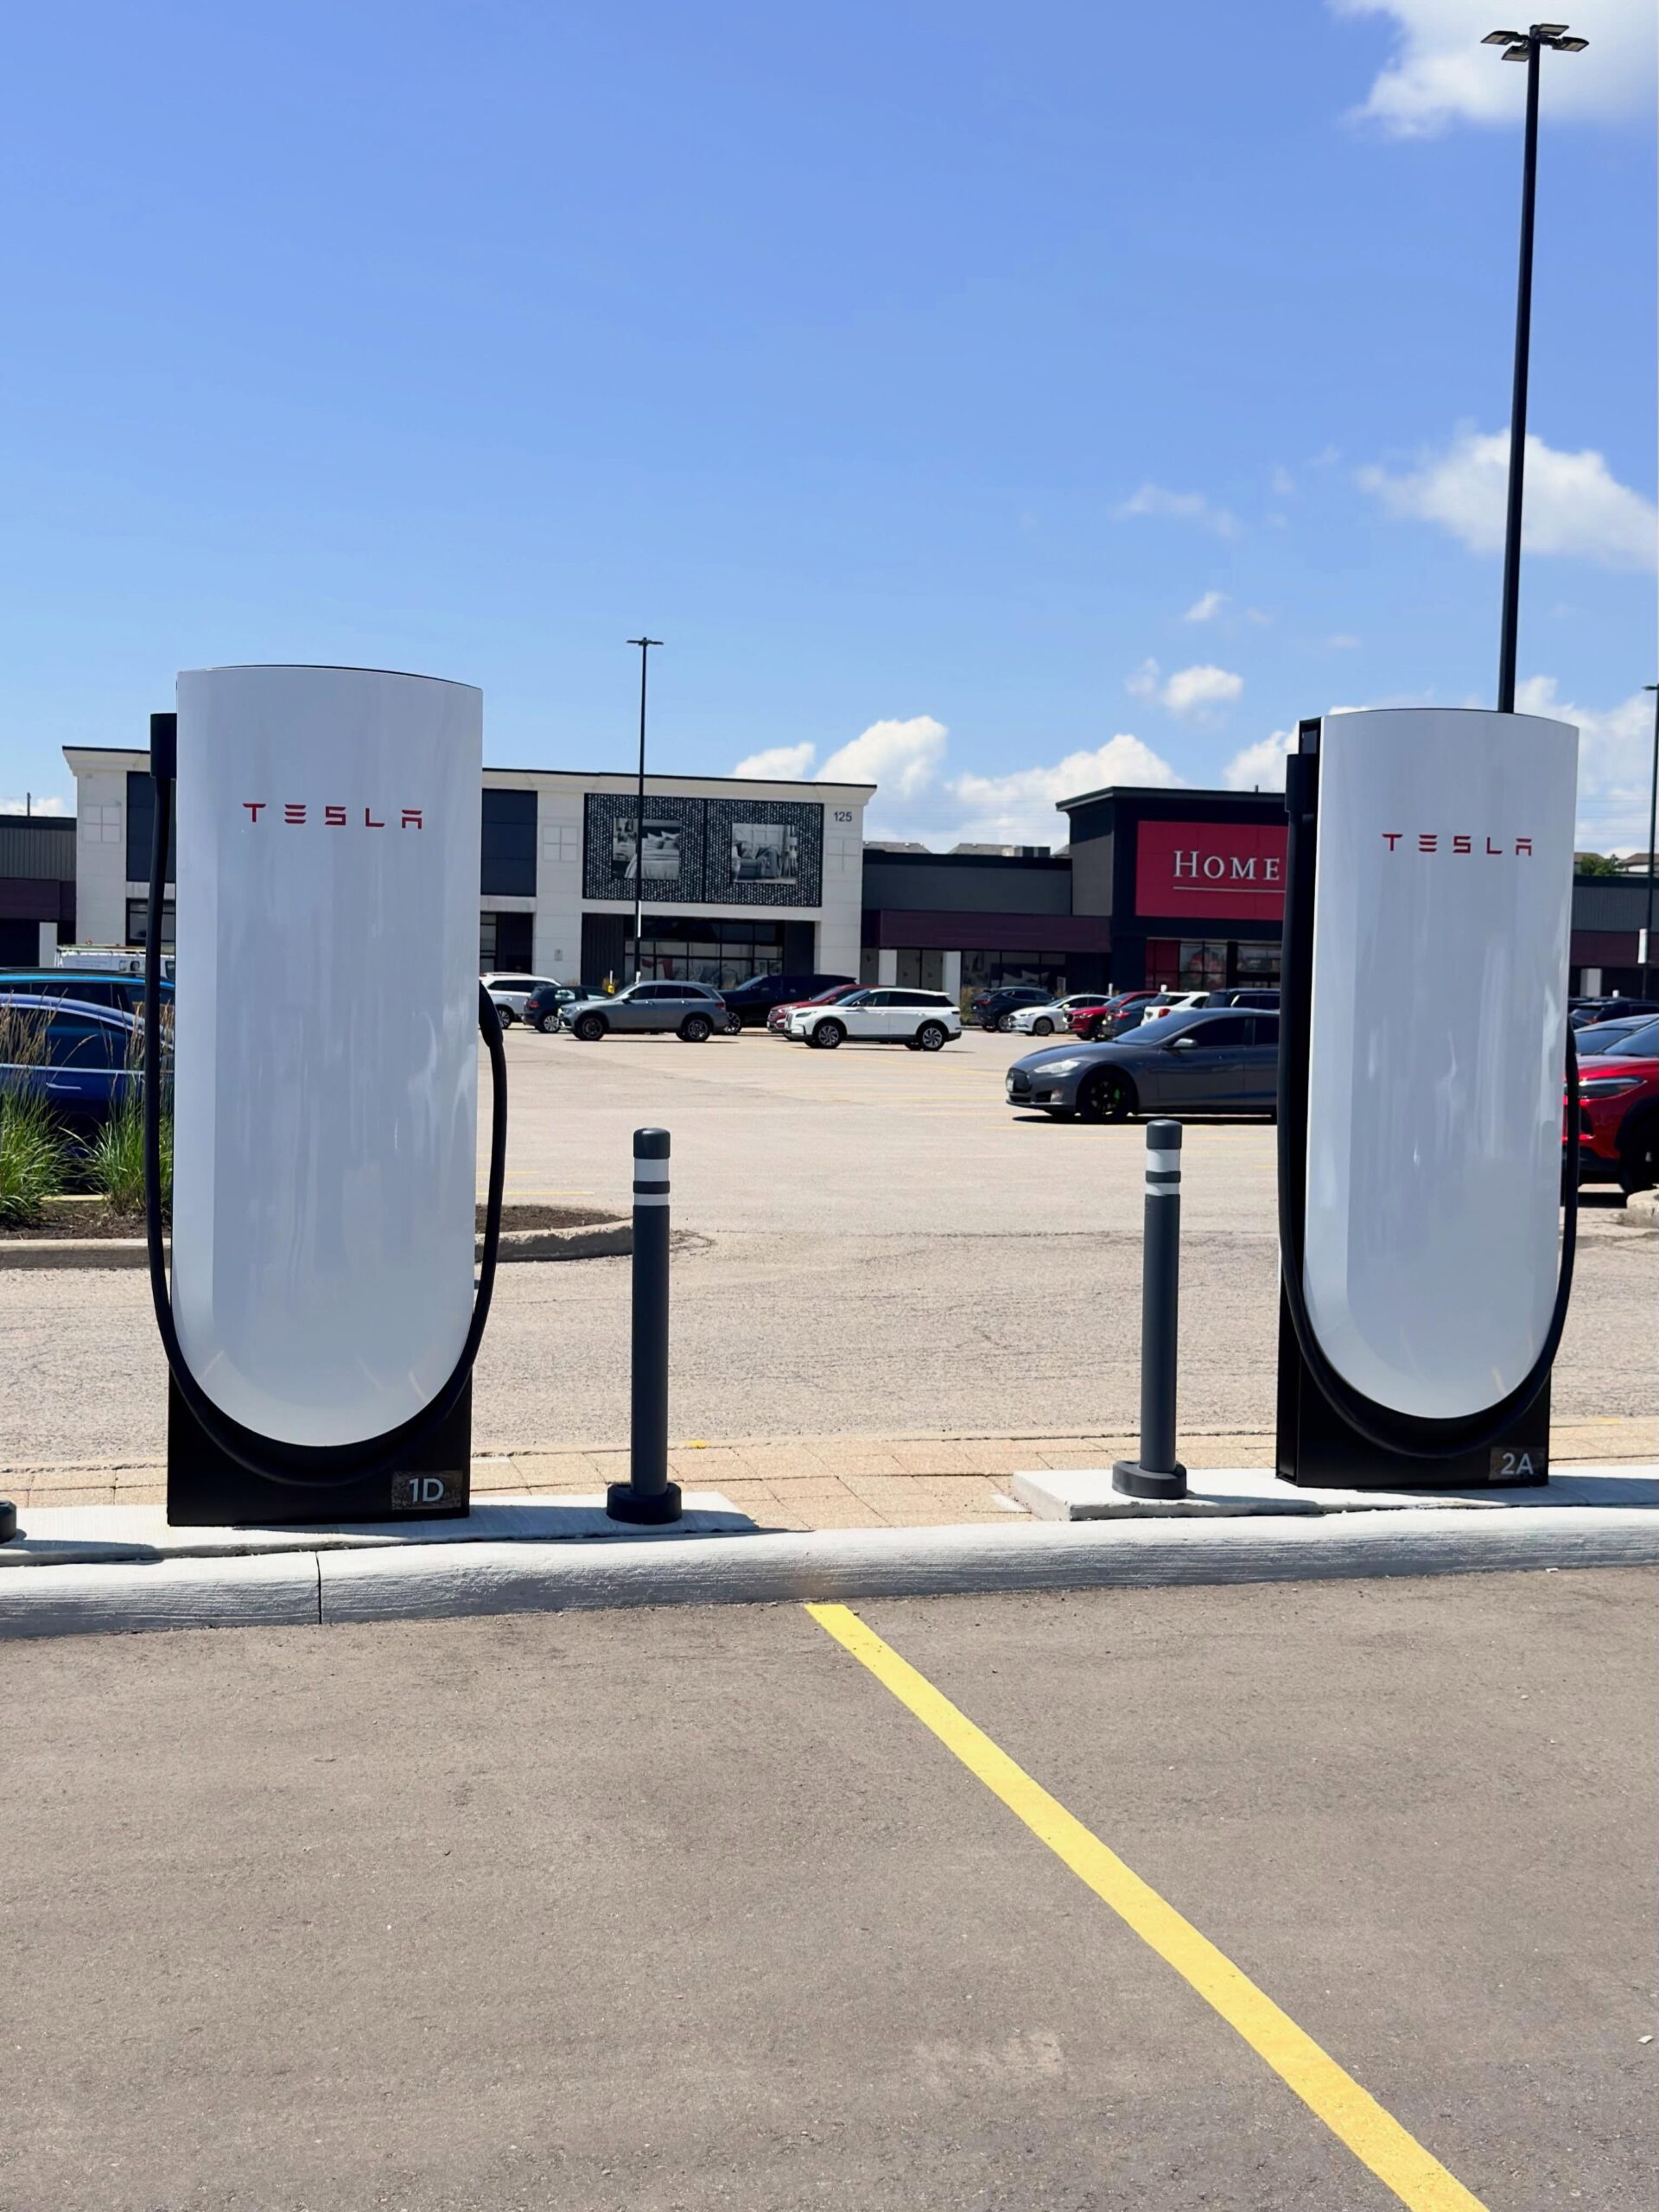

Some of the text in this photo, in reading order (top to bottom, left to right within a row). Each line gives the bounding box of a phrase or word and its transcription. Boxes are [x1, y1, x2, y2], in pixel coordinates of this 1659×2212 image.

[243, 803, 423, 830] TESLA
[834, 811, 853, 822] 125
[1382, 834, 1532, 856] TESLA
[1173, 850, 1280, 880] HOME
[1500, 1452, 1534, 1476] 2A
[409, 1478, 444, 1502] 1D
